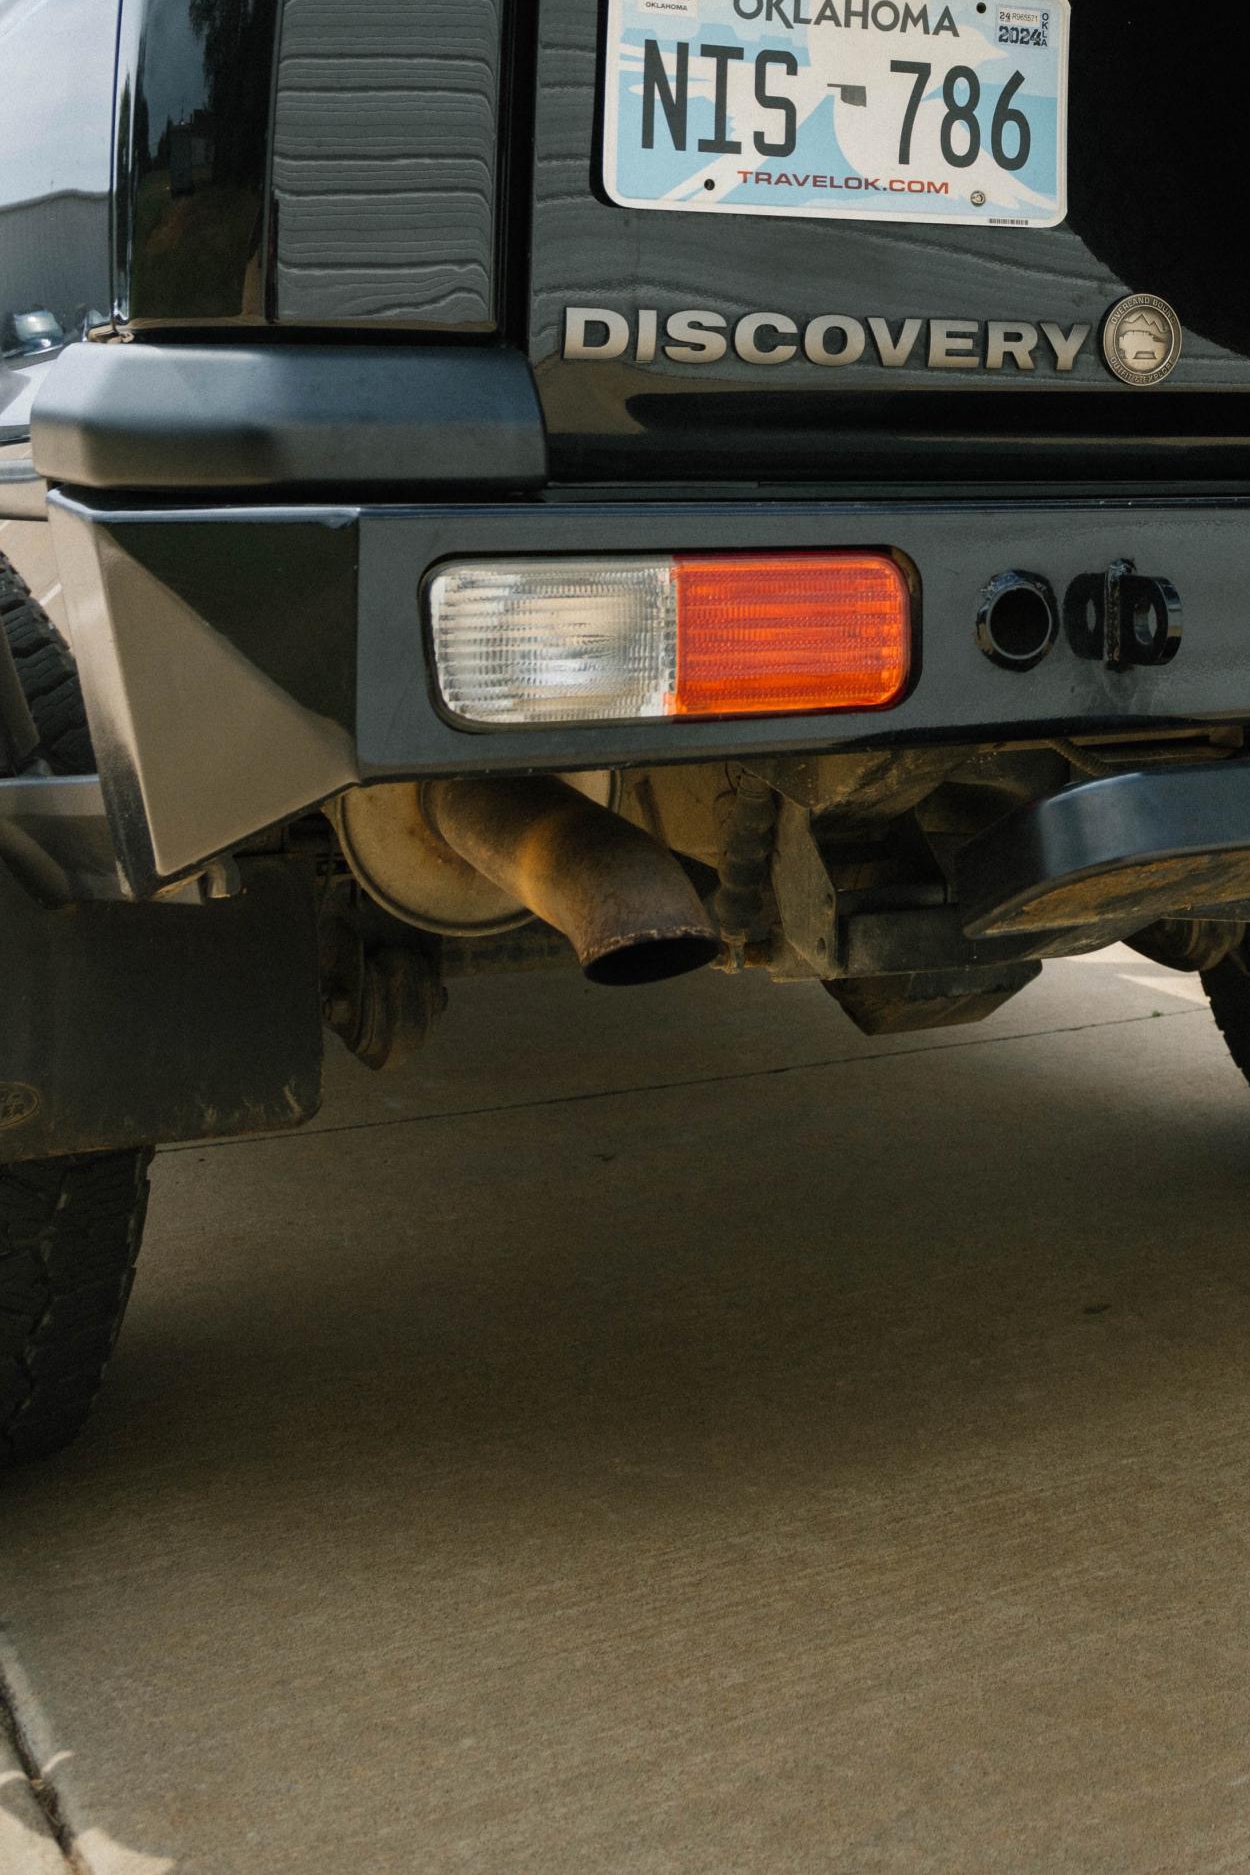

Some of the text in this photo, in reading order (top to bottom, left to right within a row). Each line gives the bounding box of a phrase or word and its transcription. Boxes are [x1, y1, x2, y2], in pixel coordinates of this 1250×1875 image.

[645, 1, 688, 11] OKLAHOMA
[998, 25, 1041, 47] 2024
[641, 38, 1032, 172] NIS 786
[736, 169, 950, 196] TRAVELOK.COM
[562, 305, 1091, 371] DISCOVERY
